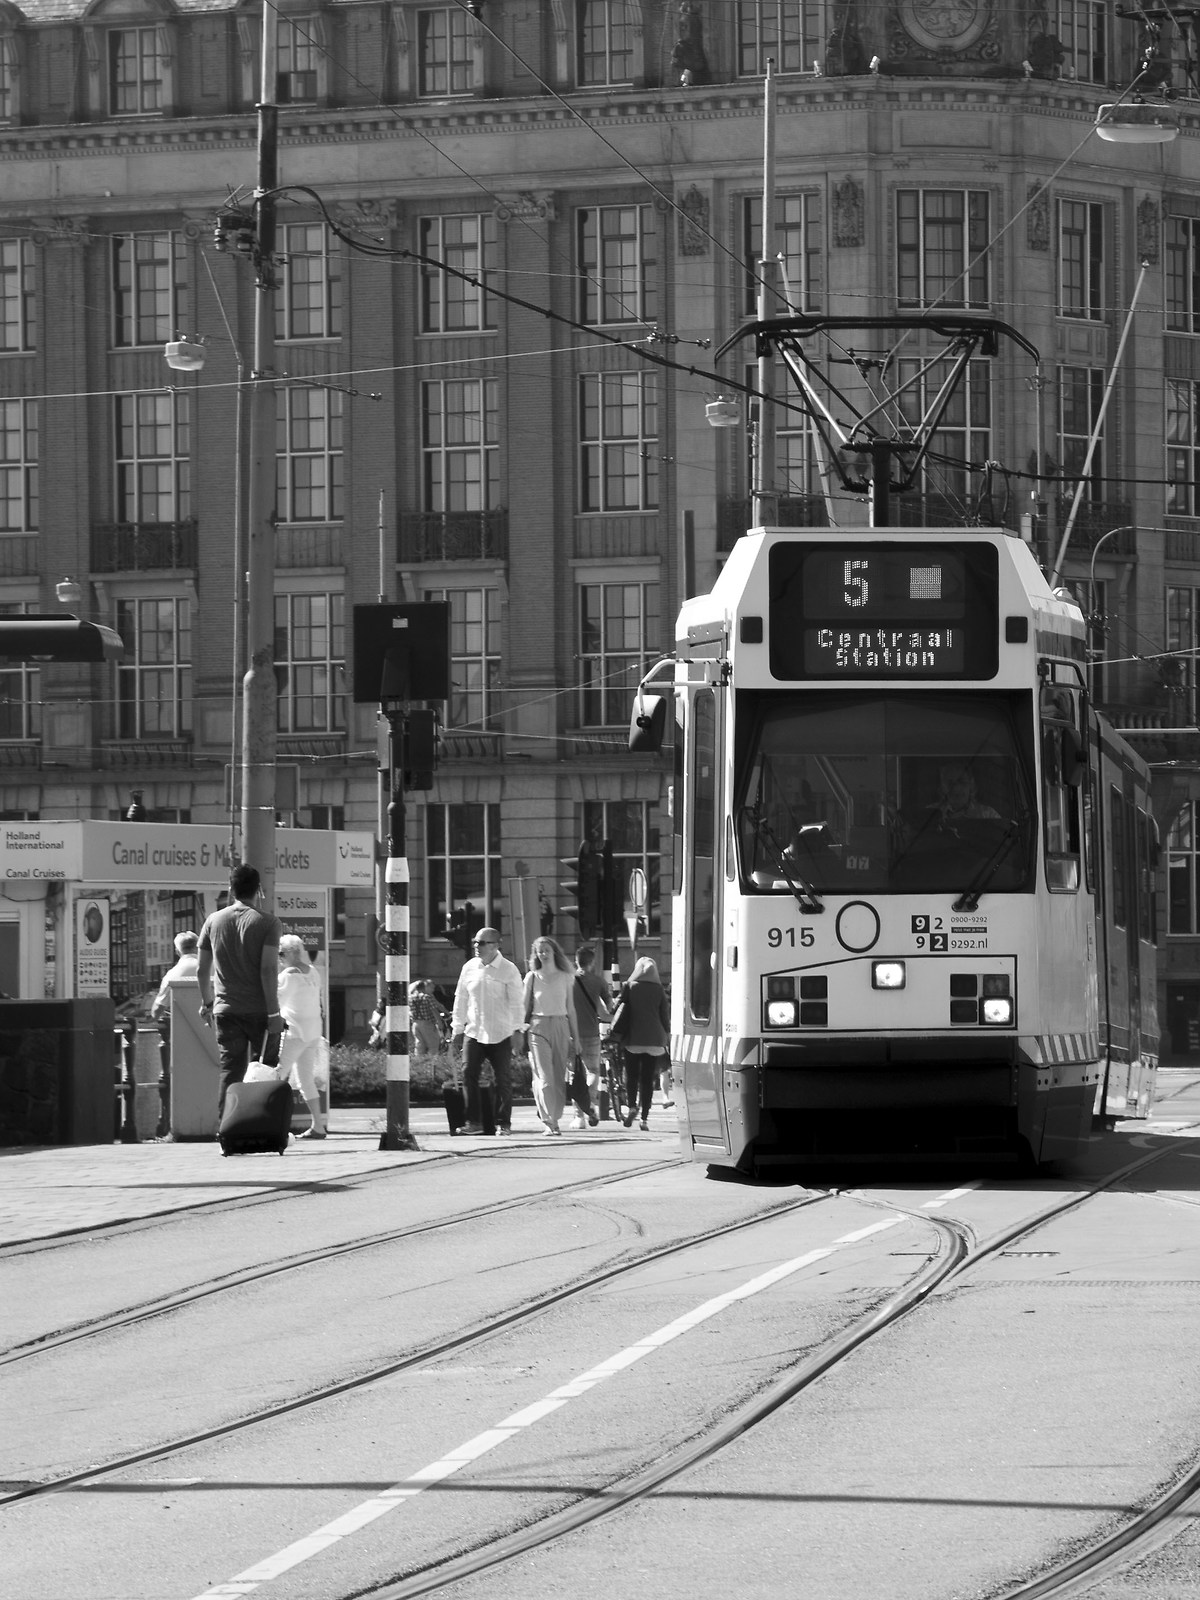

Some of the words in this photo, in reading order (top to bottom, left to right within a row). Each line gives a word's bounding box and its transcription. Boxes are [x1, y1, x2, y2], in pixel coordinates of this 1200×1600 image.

[844, 560, 869, 607] 5
[818, 629, 953, 648] Centraal
[836, 648, 935, 667] Station
[6, 831, 41, 840] Holland
[6, 841, 64, 850] International
[112, 841, 148, 865] Canal
[152, 845, 197, 867] cruises
[201, 844, 210, 867] &
[275, 847, 310, 870] ickets
[6, 869, 30, 878] Canal
[33, 868, 65, 878] Cruises
[768, 927, 815, 948] 915
[951, 938, 988, 949] 9292.nl
